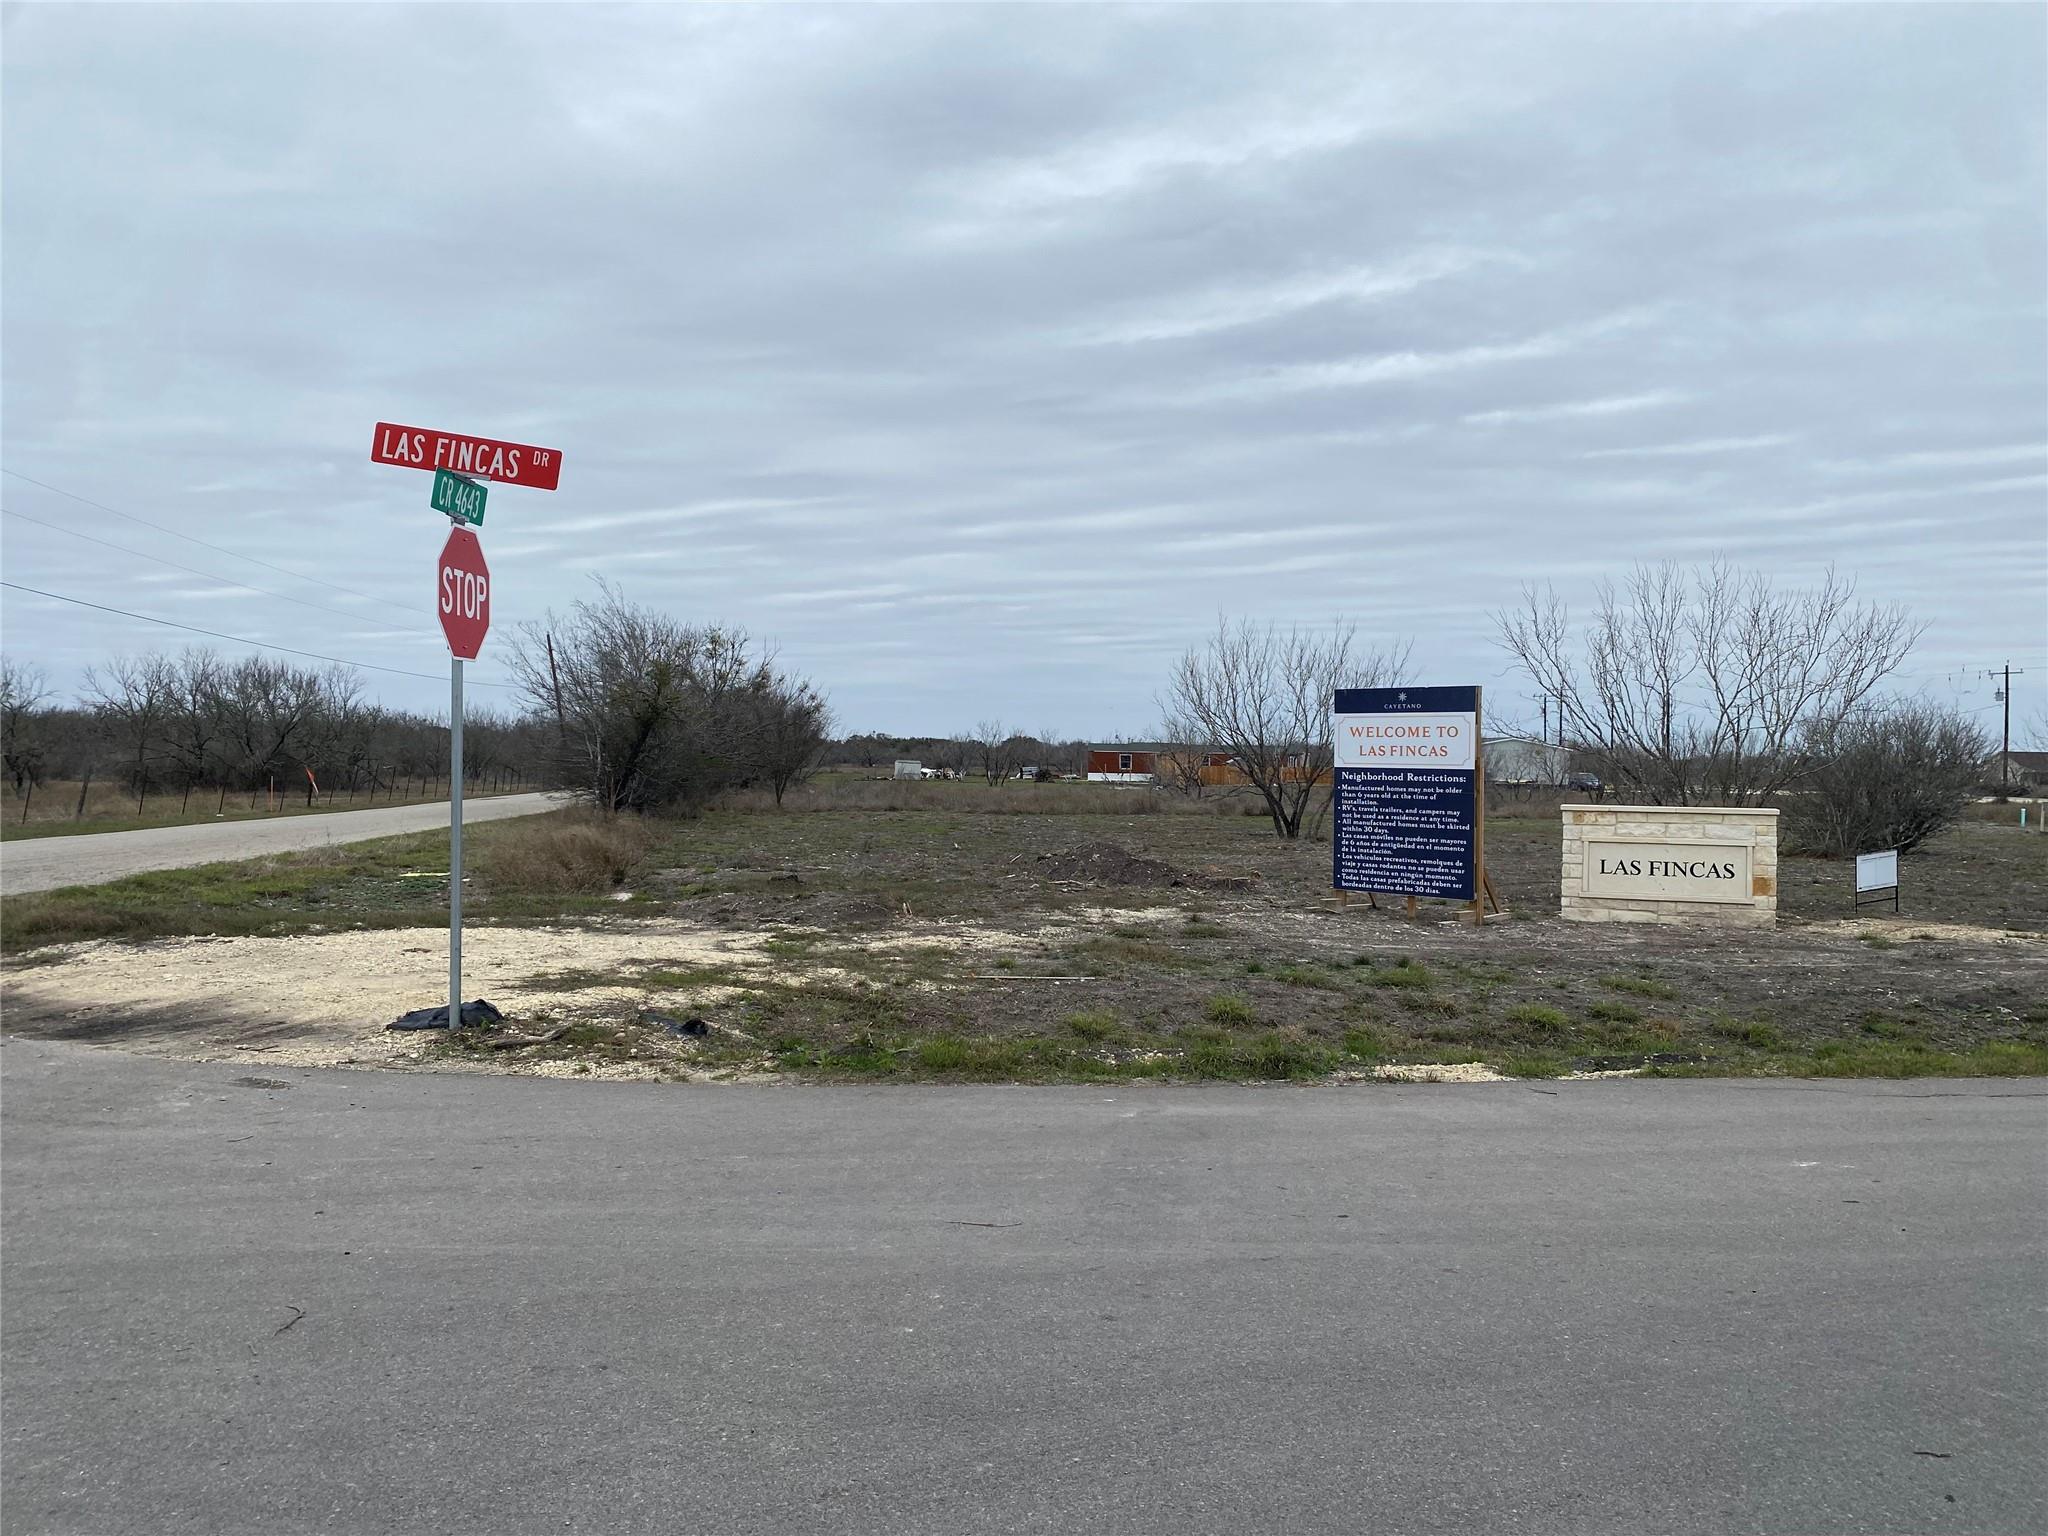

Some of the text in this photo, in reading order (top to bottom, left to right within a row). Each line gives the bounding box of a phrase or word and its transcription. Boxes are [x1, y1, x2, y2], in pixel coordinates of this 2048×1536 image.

[382, 429, 550, 478] LAS FINCAS DR
[439, 476, 481, 518] CR 4643
[442, 566, 487, 620] STOP
[1350, 726, 1459, 738] WELCOME TO
[1359, 745, 1448, 757] LAS FINCAS
[1341, 771, 1467, 783] Neighborhood Restrictions:
[1352, 819, 1397, 827] manufactured
[1397, 820, 1419, 828] homes
[1446, 823, 1471, 831] skirted
[1342, 831, 1353, 839] Las
[1404, 835, 1428, 843] pueden
[1342, 852, 1354, 860] Los
[1420, 858, 1454, 867] remolques
[1455, 859, 1464, 867] de
[1359, 868, 1391, 876] residencia
[1379, 862, 1408, 870] rodantes
[1600, 858, 1736, 879] LAS FINCAS
[1341, 872, 1360, 881] Todas
[1387, 877, 1432, 886] prefabricadas
[1431, 880, 1452, 888] deben
[1341, 879, 1373, 888] bordeadas
[1373, 882, 1395, 890] dentro
